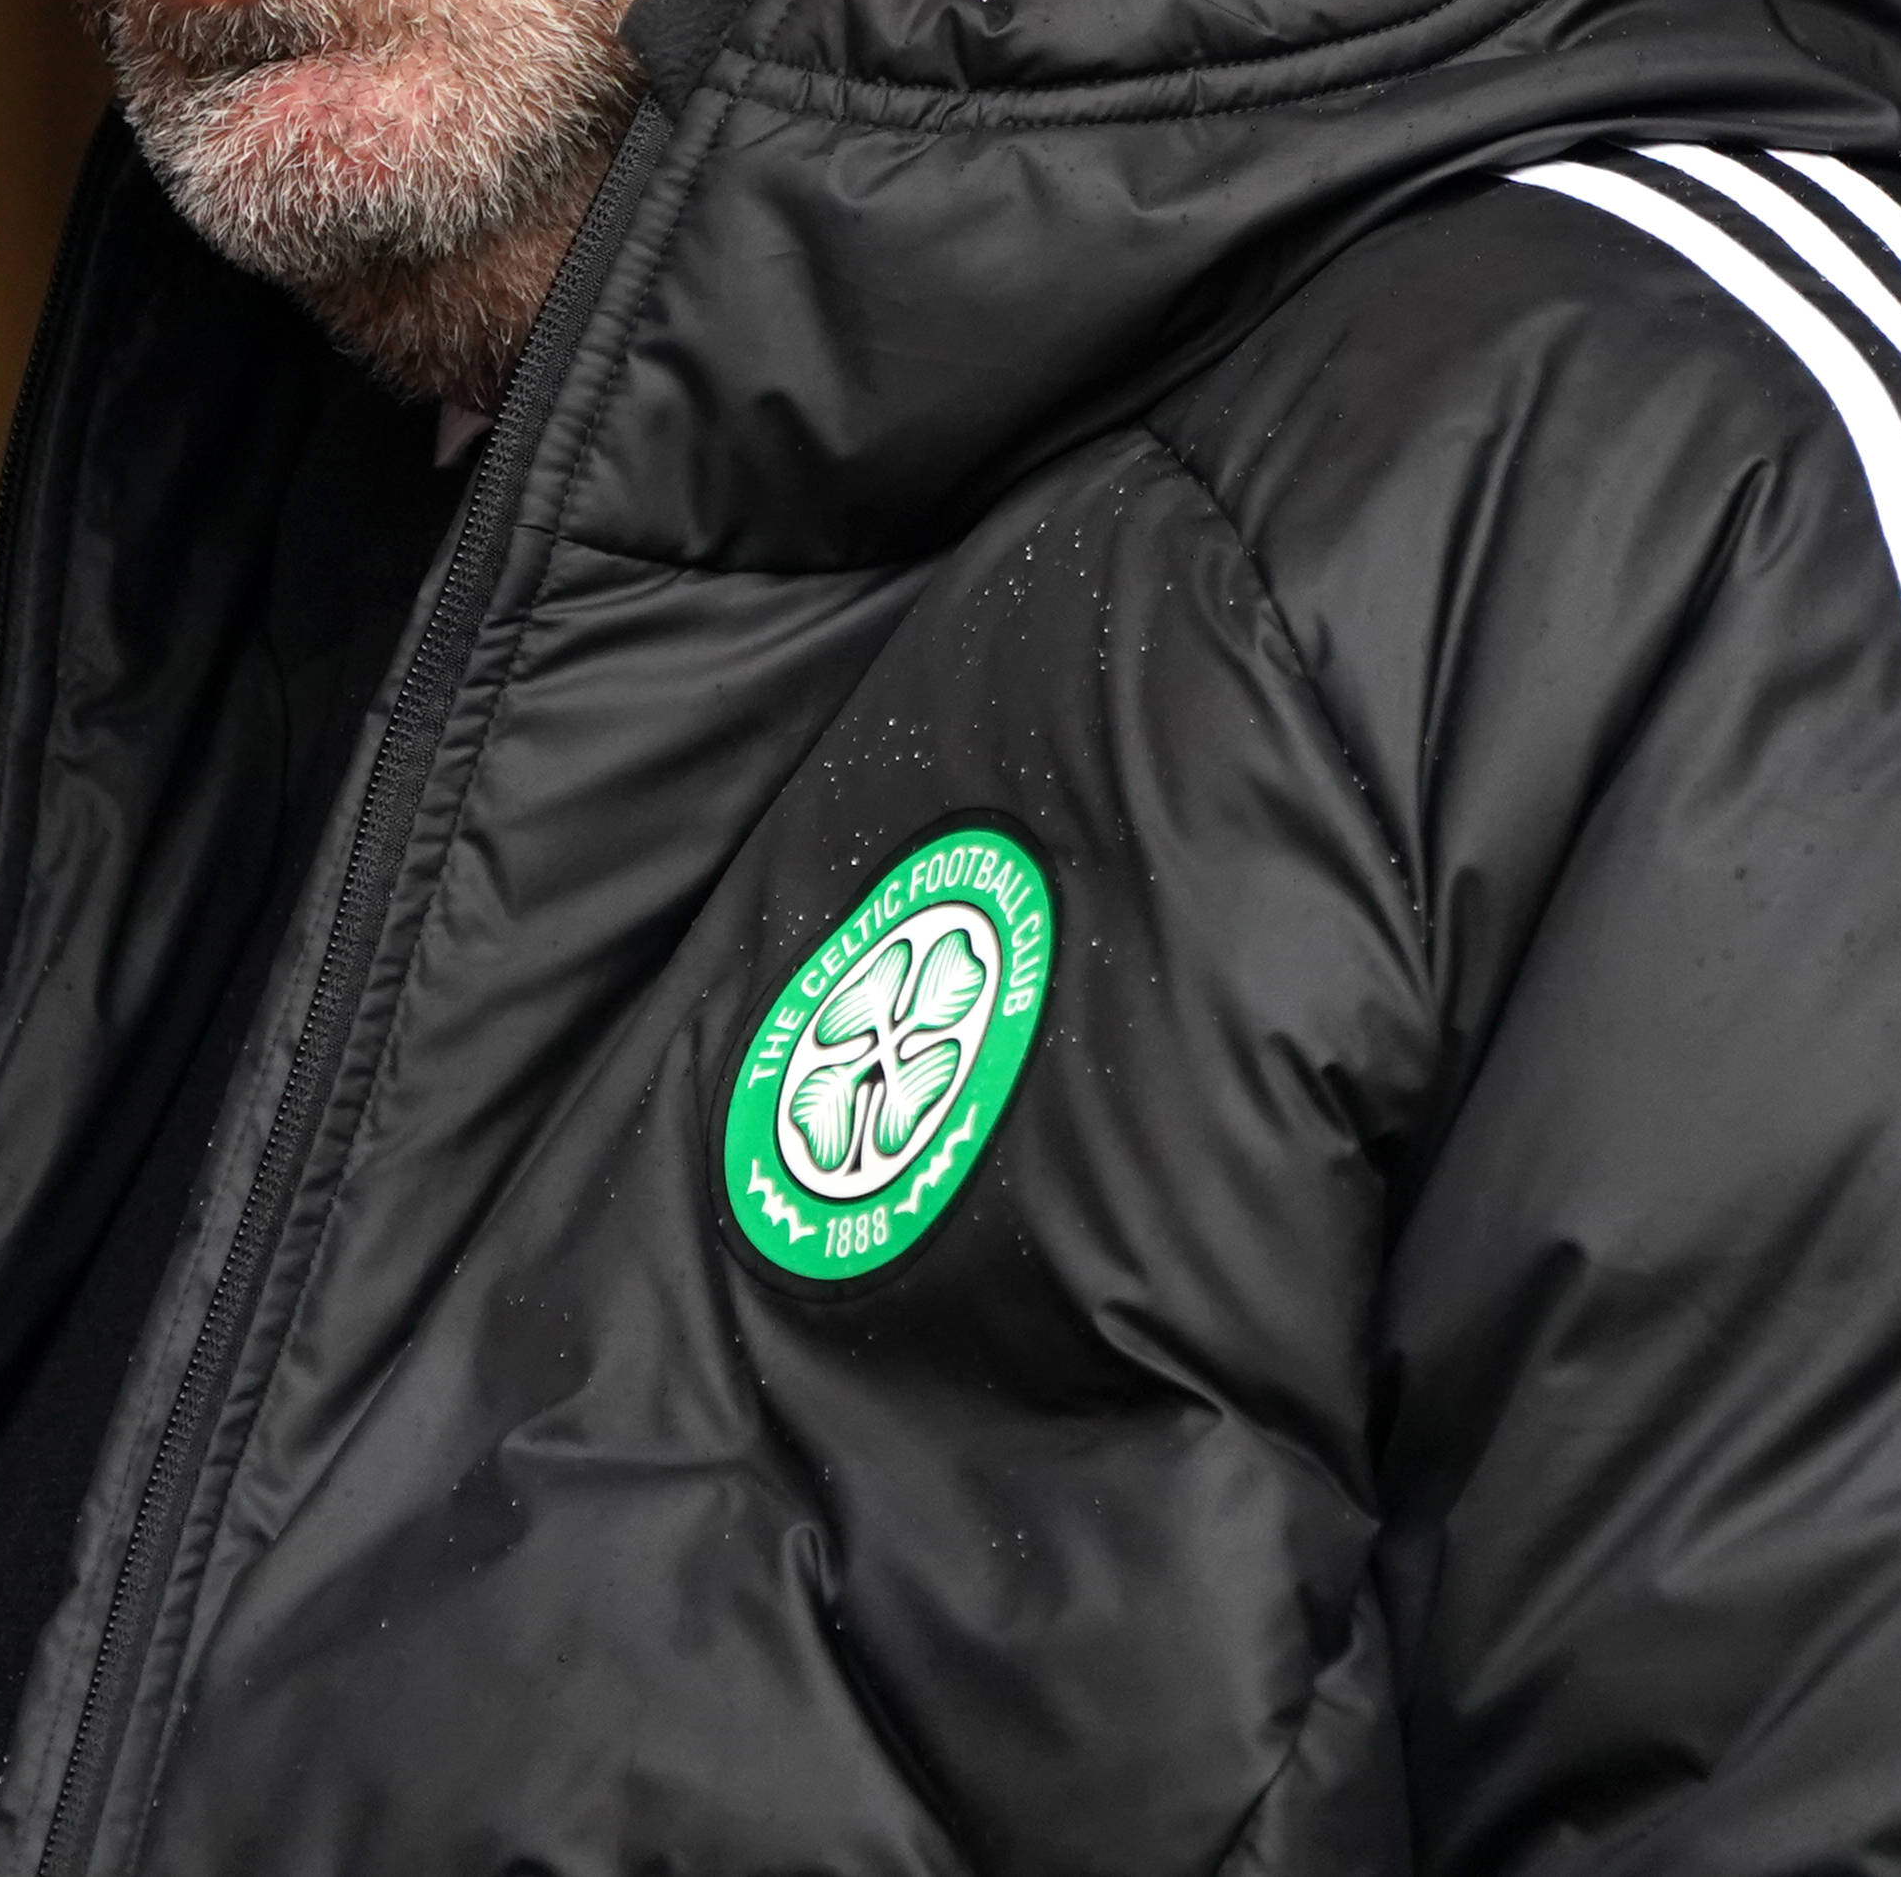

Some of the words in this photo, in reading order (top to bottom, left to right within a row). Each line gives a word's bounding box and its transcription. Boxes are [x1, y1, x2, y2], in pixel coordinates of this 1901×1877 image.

[748, 1006, 803, 1089] THE
[801, 881, 904, 999] CELTIC
[908, 845, 1032, 925] FOOTBALL
[1003, 914, 1043, 1017] CLUB
[824, 1209, 889, 1258] 1888
